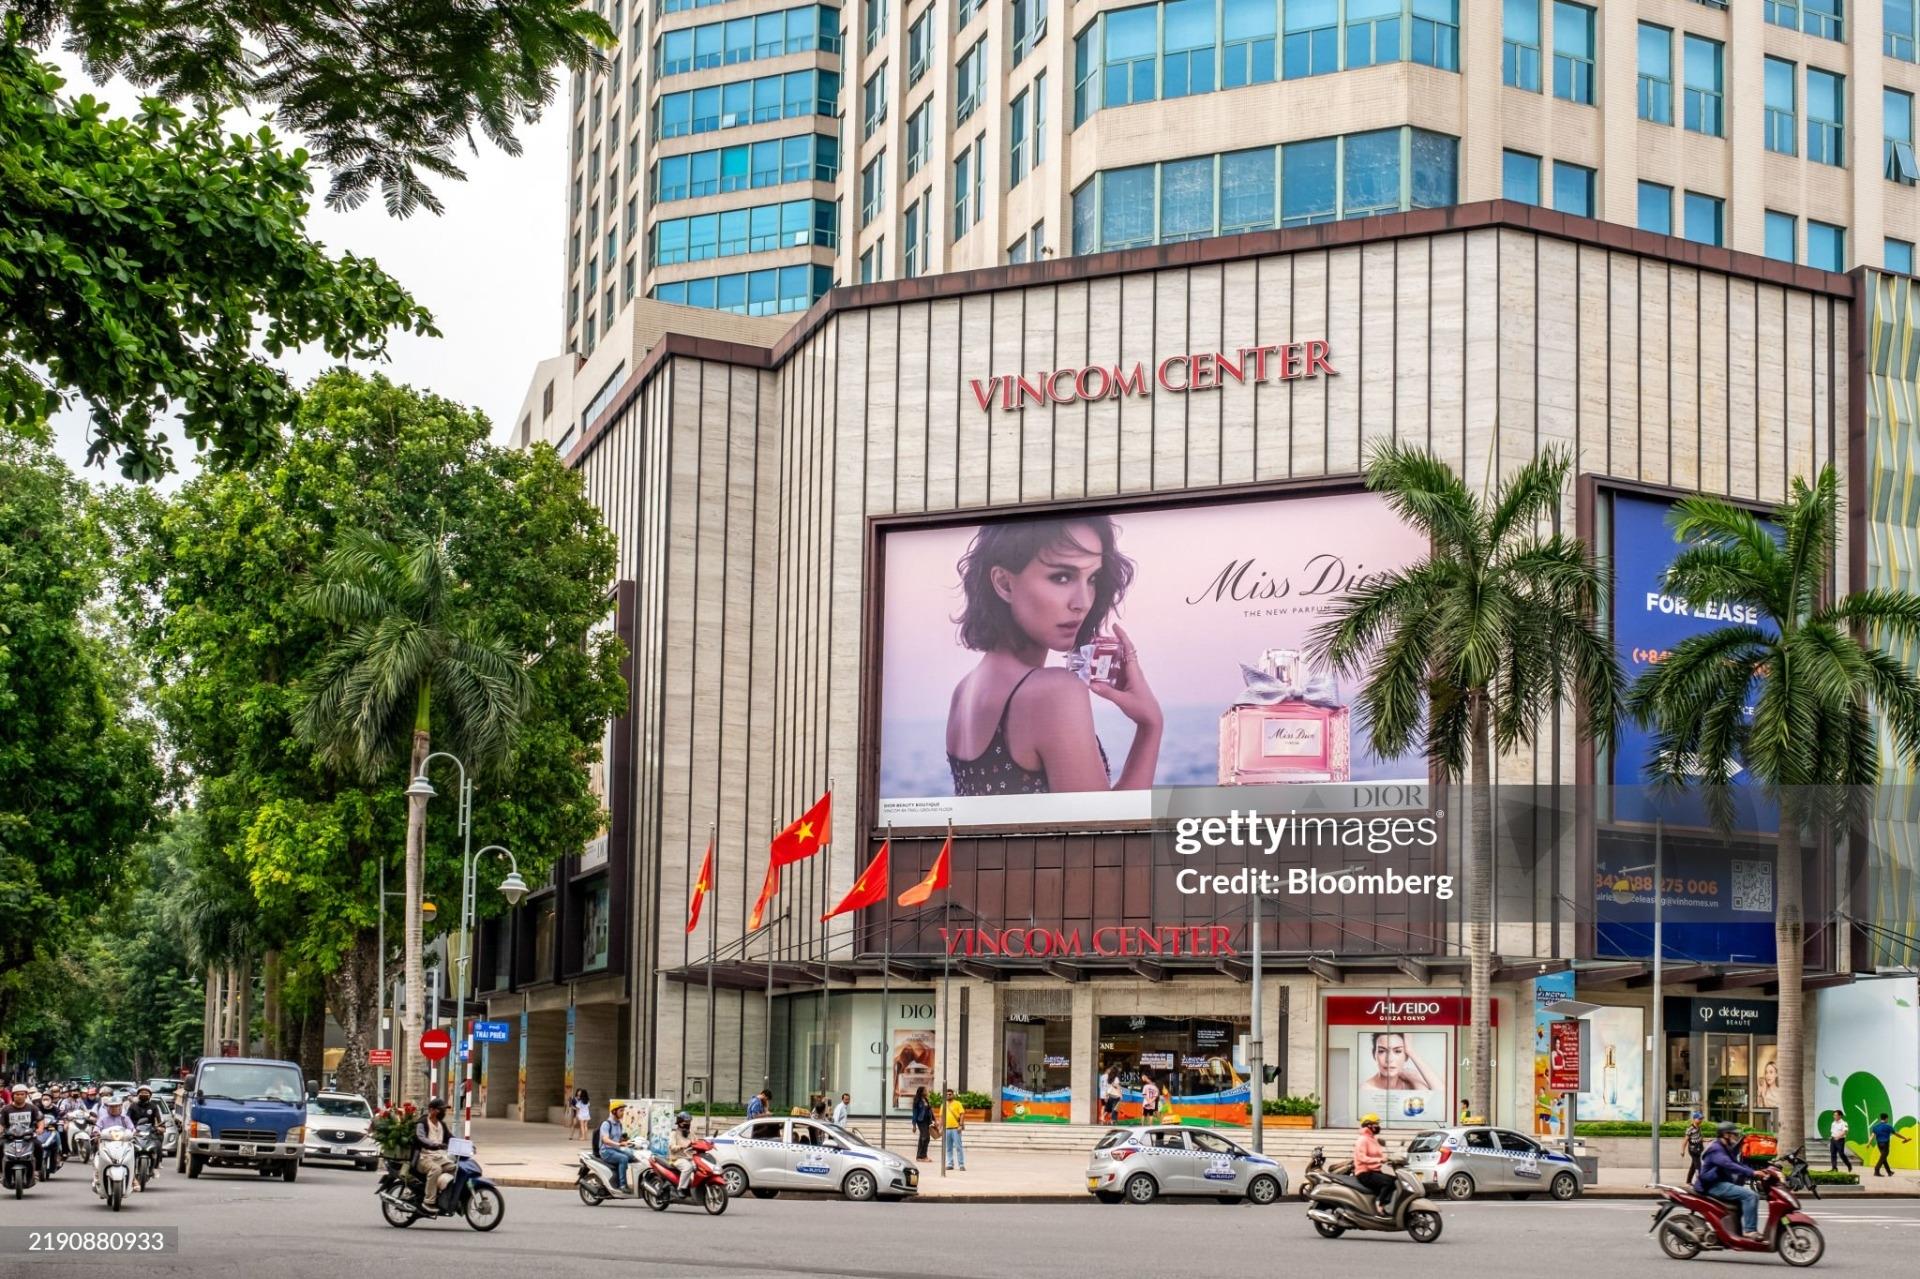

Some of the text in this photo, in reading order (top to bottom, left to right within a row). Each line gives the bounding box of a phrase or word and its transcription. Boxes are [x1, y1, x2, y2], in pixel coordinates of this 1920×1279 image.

[969, 338, 1340, 411] VINCOM CENTER
[1186, 557, 1290, 605] Miss
[1243, 605, 1331, 618] THE NEW PARFUM
[1646, 592, 1758, 626] FOR LEASE
[1353, 784, 1424, 808] DIOR
[1687, 879, 1718, 896] 006
[938, 925, 1238, 958] VINCOM CENTER
[1365, 1001, 1440, 1015] SHISEIDO
[1730, 1007, 1740, 1017] de
